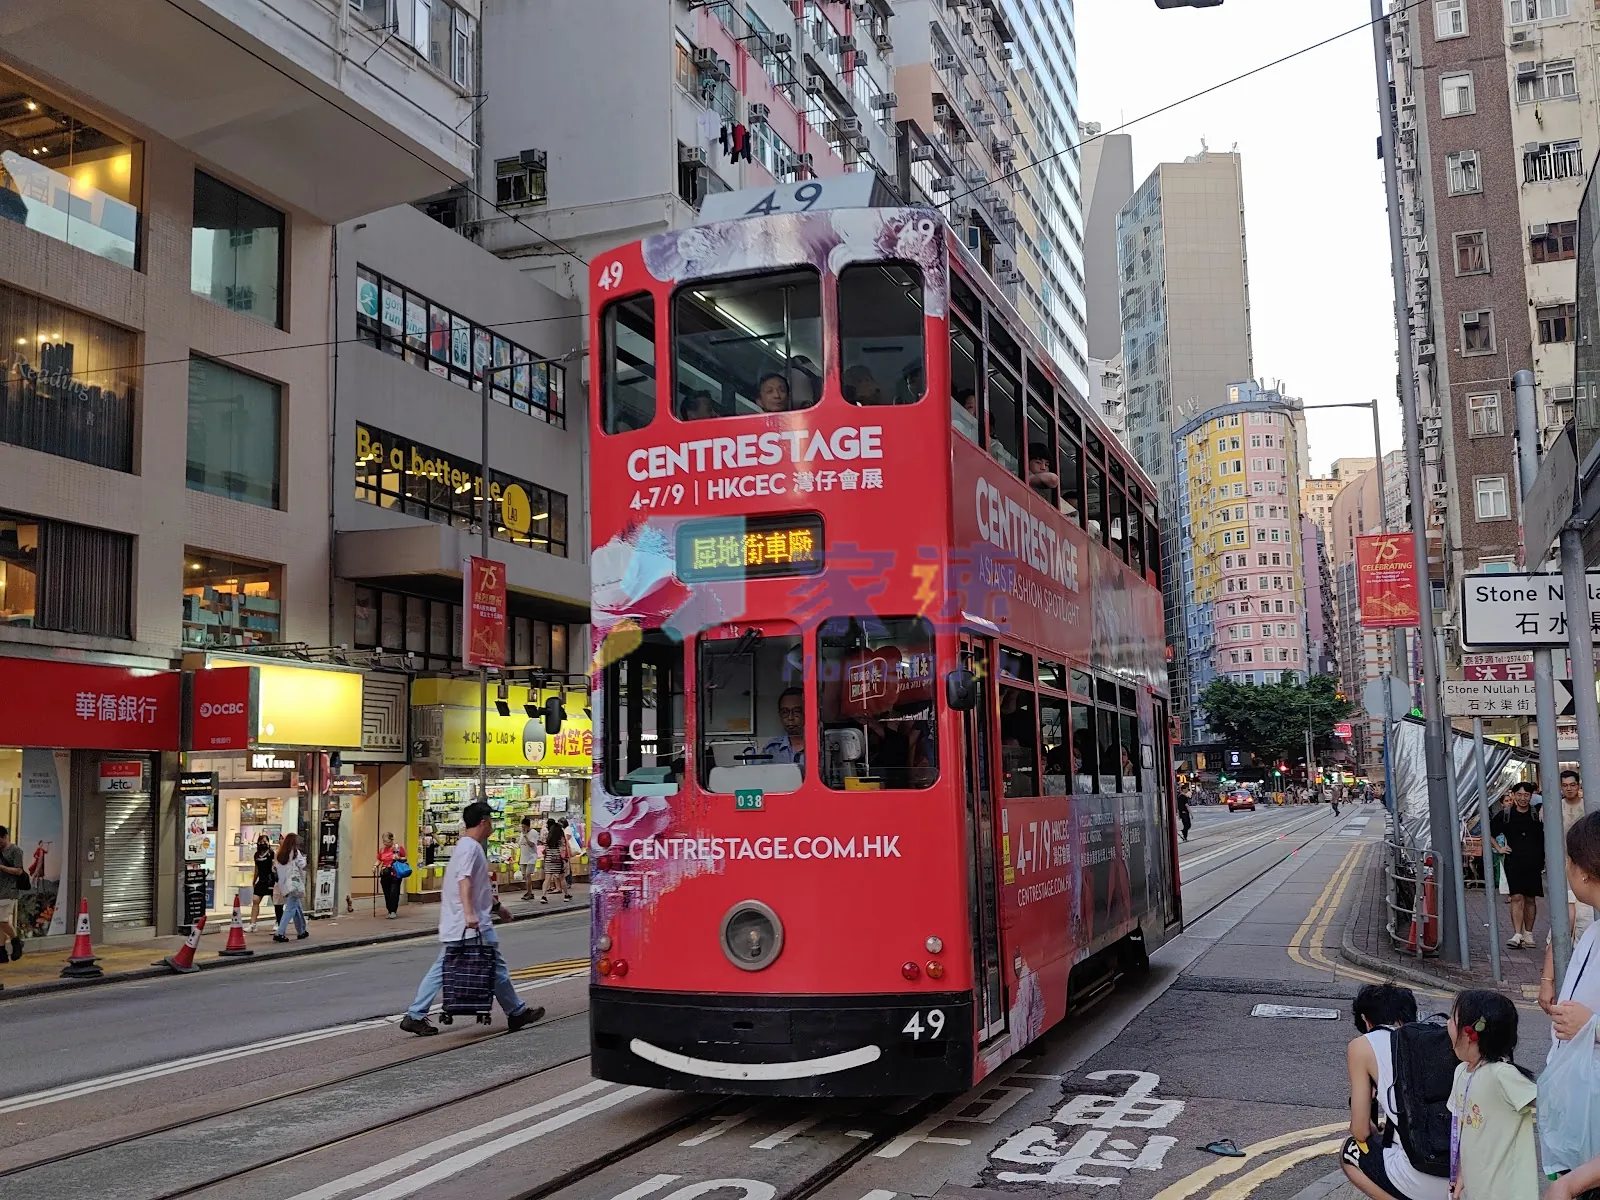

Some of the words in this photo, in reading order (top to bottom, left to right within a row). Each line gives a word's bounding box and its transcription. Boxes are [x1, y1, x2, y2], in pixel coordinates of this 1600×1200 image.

[745, 182, 823, 215] 49
[597, 261, 623, 291] 49
[12, 352, 90, 401] Reading
[356, 426, 384, 464] Be
[390, 447, 404, 471] a
[411, 446, 470, 490] better
[627, 426, 883, 481] CENTRESTAGE
[629, 484, 685, 510] 4-7/9
[707, 473, 786, 501] HKCEC
[792, 468, 884, 493] 灣仔會展
[975, 476, 1079, 593] CENTRESTAGE
[692, 528, 814, 570] 屈地街車廠
[1371, 538, 1399, 563] 75
[480, 565, 498, 592] 75
[1361, 562, 1413, 572] CELEBRATING
[978, 554, 1007, 592] ASIA'S
[1009, 568, 1044, 609] FASHION
[1044, 588, 1080, 628] SPOTLIGHT
[1476, 585, 1538, 602] Stone
[1447, 685, 1479, 694] Stone
[1483, 684, 1520, 694] Nullah
[1524, 685, 1536, 694] La
[76, 692, 157, 724] 華僑銀行
[213, 703, 244, 716] OCBC
[1467, 699, 1529, 711] 石水渠街
[471, 732, 492, 744] CHP
[251, 753, 276, 769] HKT
[737, 794, 763, 808] 038
[1052, 820, 1070, 842] HKCEC
[629, 834, 902, 860] CENTRESTAGE.COM.HK
[1017, 819, 1051, 876] 4-7/9
[1017, 873, 1073, 907] CENTRESTAGE.COM.HK
[902, 1008, 946, 1041] 49
